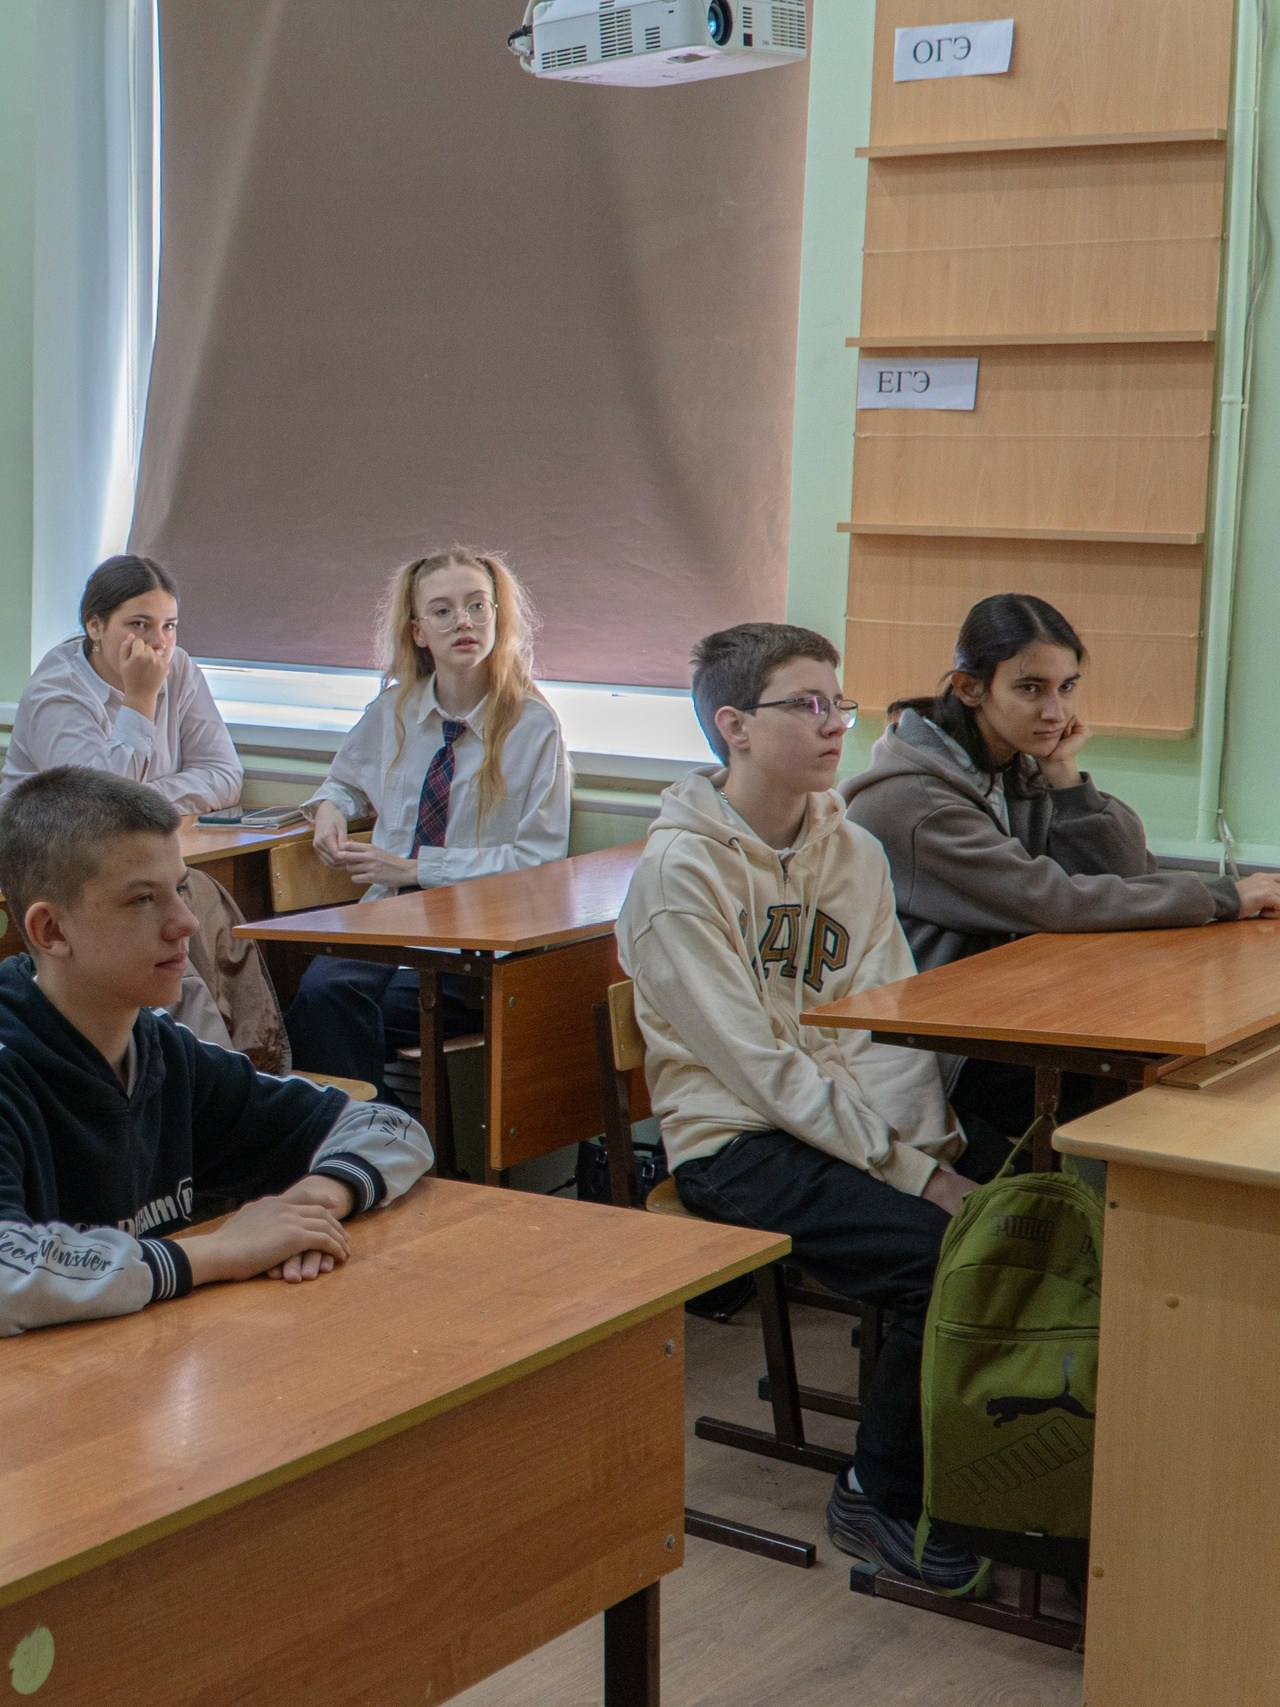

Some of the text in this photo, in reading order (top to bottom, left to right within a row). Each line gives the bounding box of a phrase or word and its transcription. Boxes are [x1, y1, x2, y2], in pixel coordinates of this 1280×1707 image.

[911, 36, 972, 65] ОГЭ
[876, 370, 931, 394] ЕГЭ
[990, 1215, 1055, 1243] PUMA
[945, 1415, 1090, 1506] PUMA
